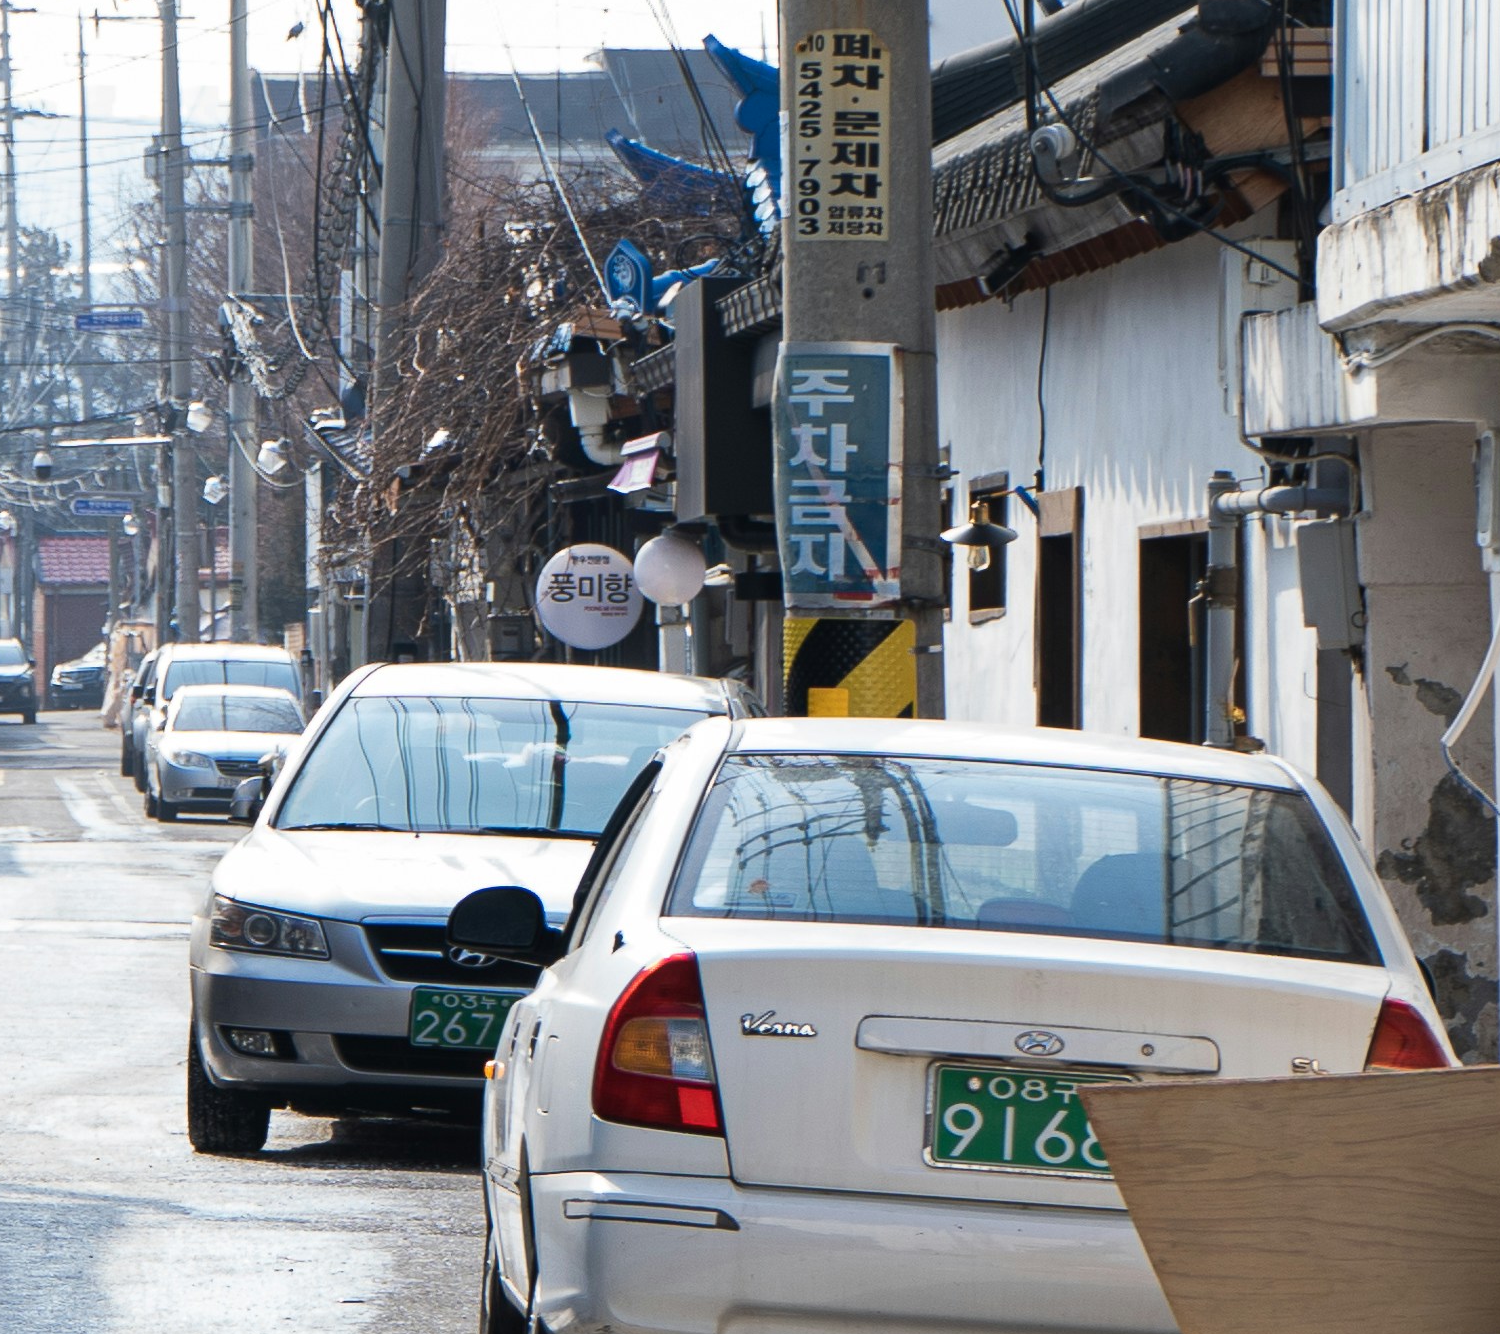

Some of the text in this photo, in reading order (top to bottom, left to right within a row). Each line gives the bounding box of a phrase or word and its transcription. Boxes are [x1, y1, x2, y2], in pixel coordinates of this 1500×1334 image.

[789, 369, 859, 582] 주차금지
[547, 572, 634, 604] 풍미향
[415, 1009, 496, 1046] 267
[740, 1010, 818, 1037] Verna
